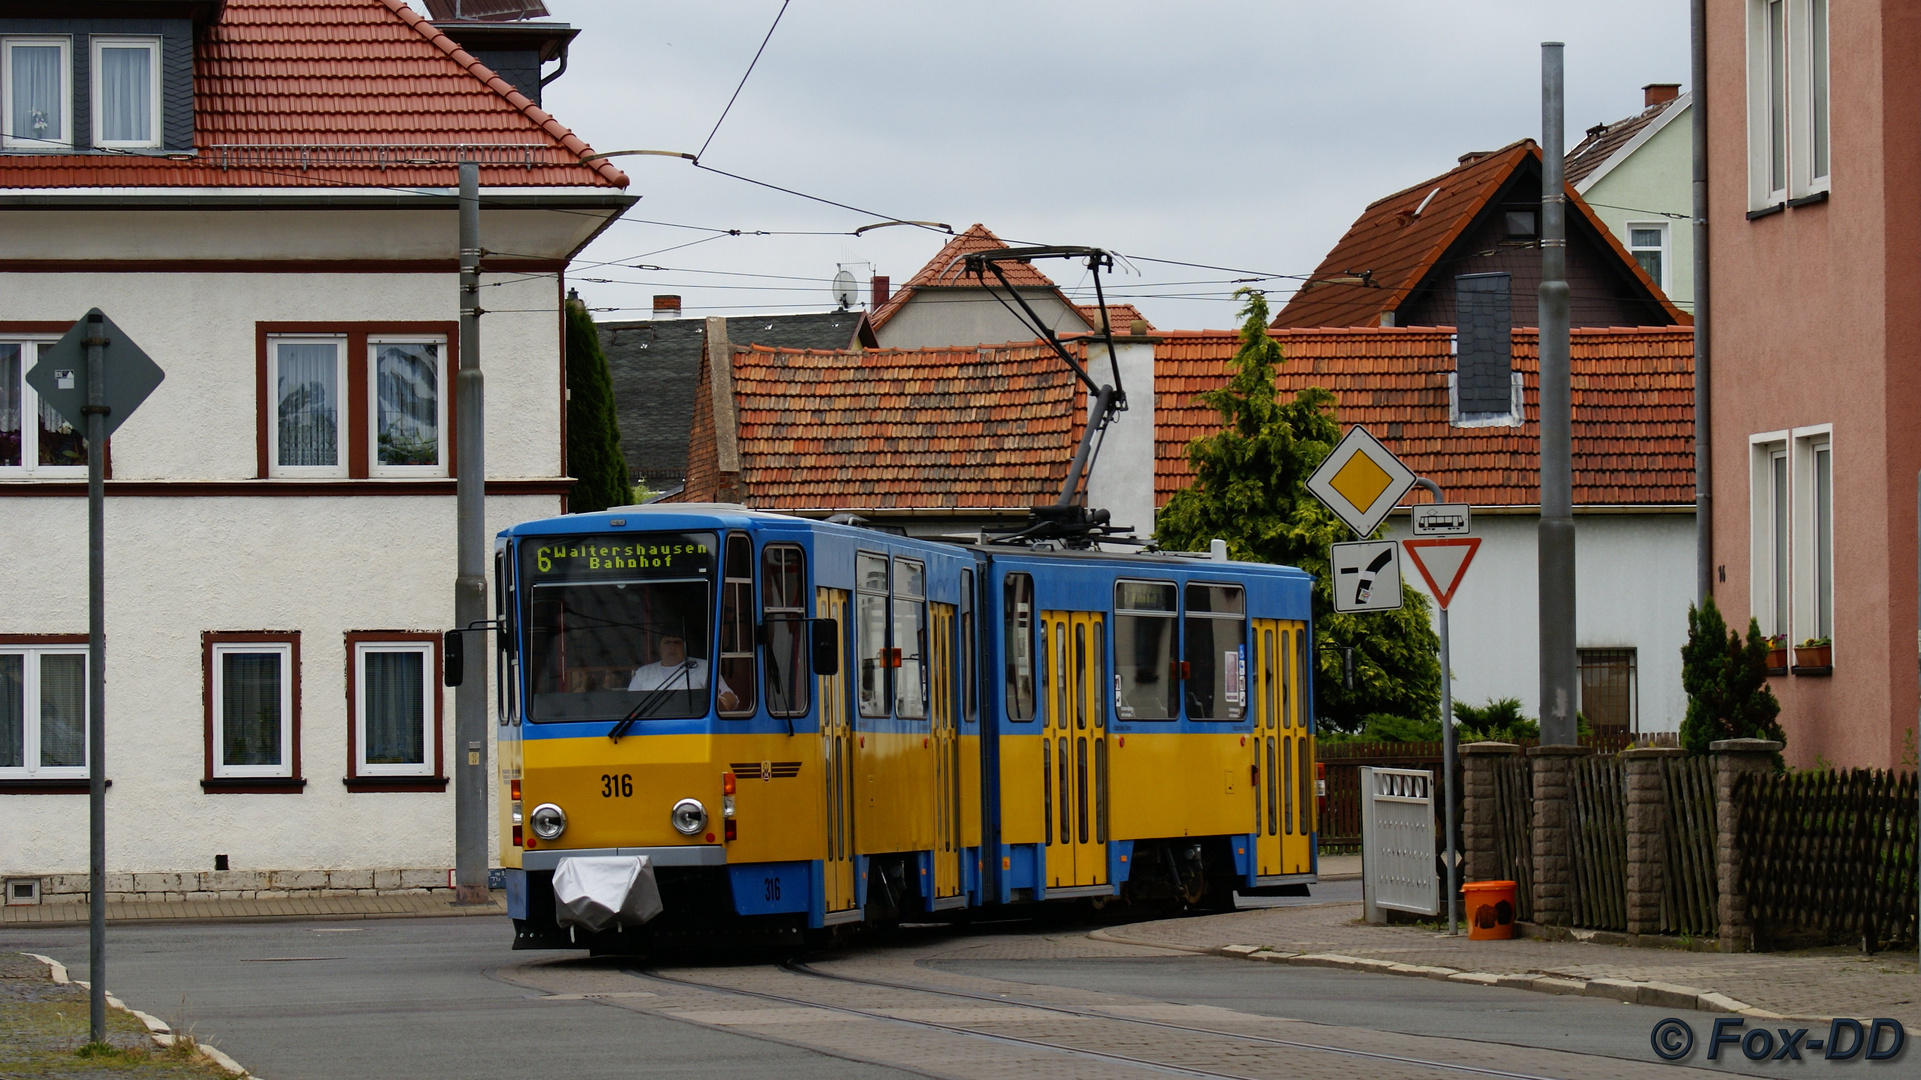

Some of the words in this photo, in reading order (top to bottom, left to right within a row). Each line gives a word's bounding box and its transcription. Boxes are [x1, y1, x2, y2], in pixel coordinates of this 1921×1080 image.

[537, 547, 551, 572] 6
[554, 544, 707, 558] Waltershausen
[589, 555, 672, 569] Bahnhof
[601, 773, 633, 798] 316
[764, 877, 781, 901] 316
